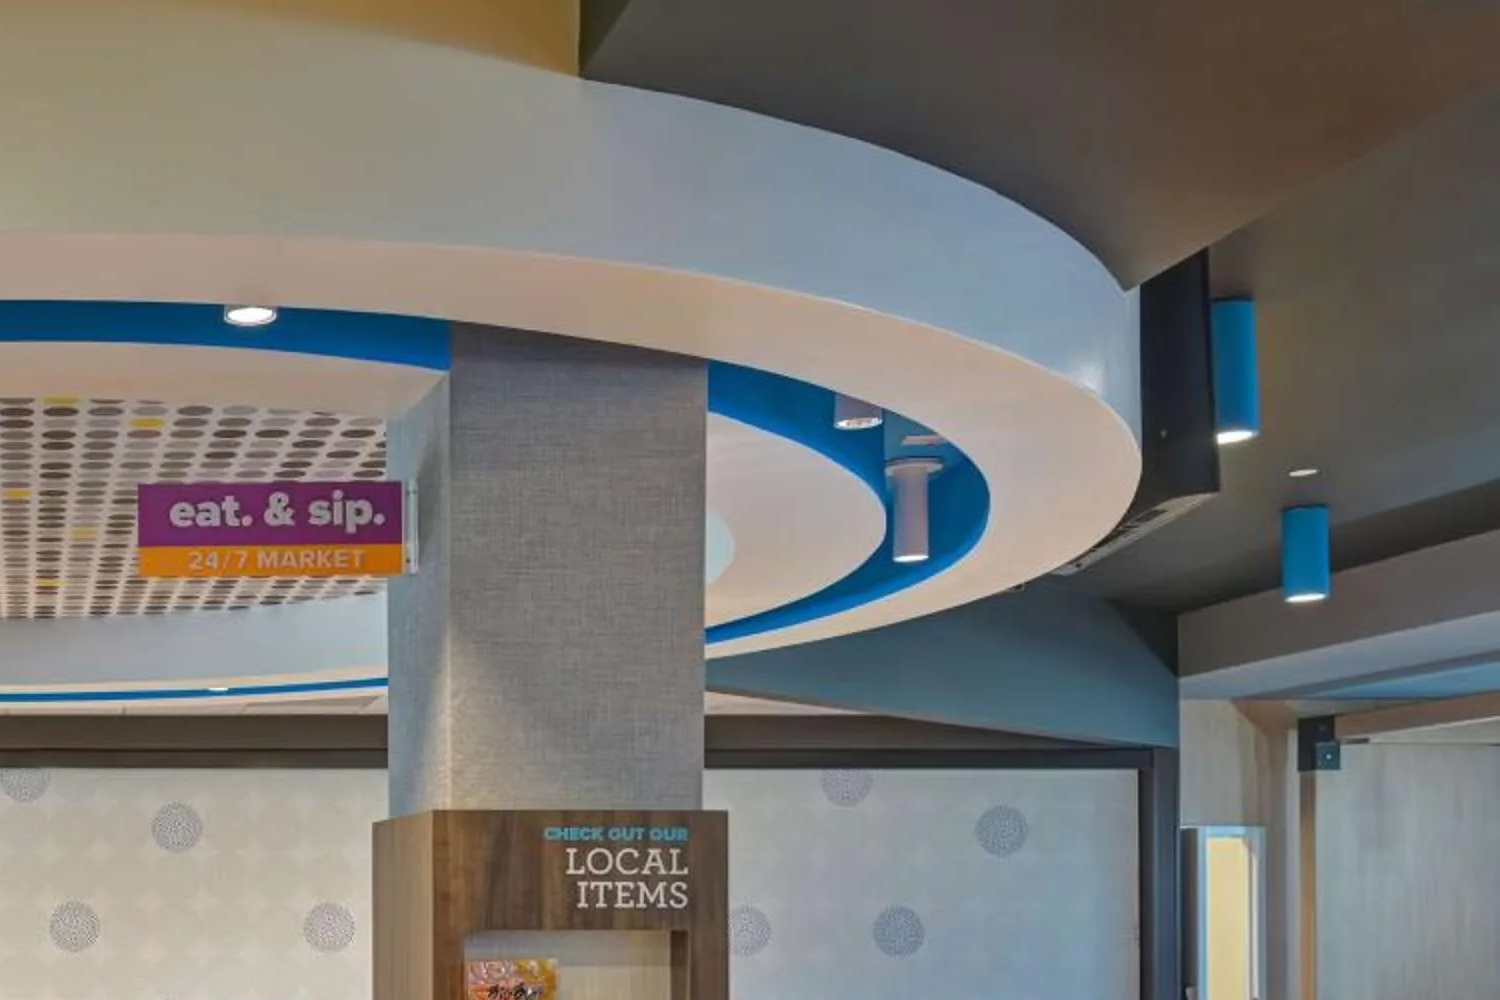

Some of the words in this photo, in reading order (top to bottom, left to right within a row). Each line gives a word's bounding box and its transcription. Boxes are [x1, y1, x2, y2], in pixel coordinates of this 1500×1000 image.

[169, 495, 253, 527] eat.
[264, 491, 295, 526] &
[308, 489, 386, 534] sip.
[188, 551, 248, 570] 24/7
[256, 549, 365, 569] MARKET
[543, 827, 604, 841] CHECK
[608, 827, 644, 841] OUT
[649, 827, 689, 841] OUR
[565, 847, 689, 876] LOCAL
[576, 881, 689, 909] ITEMS
